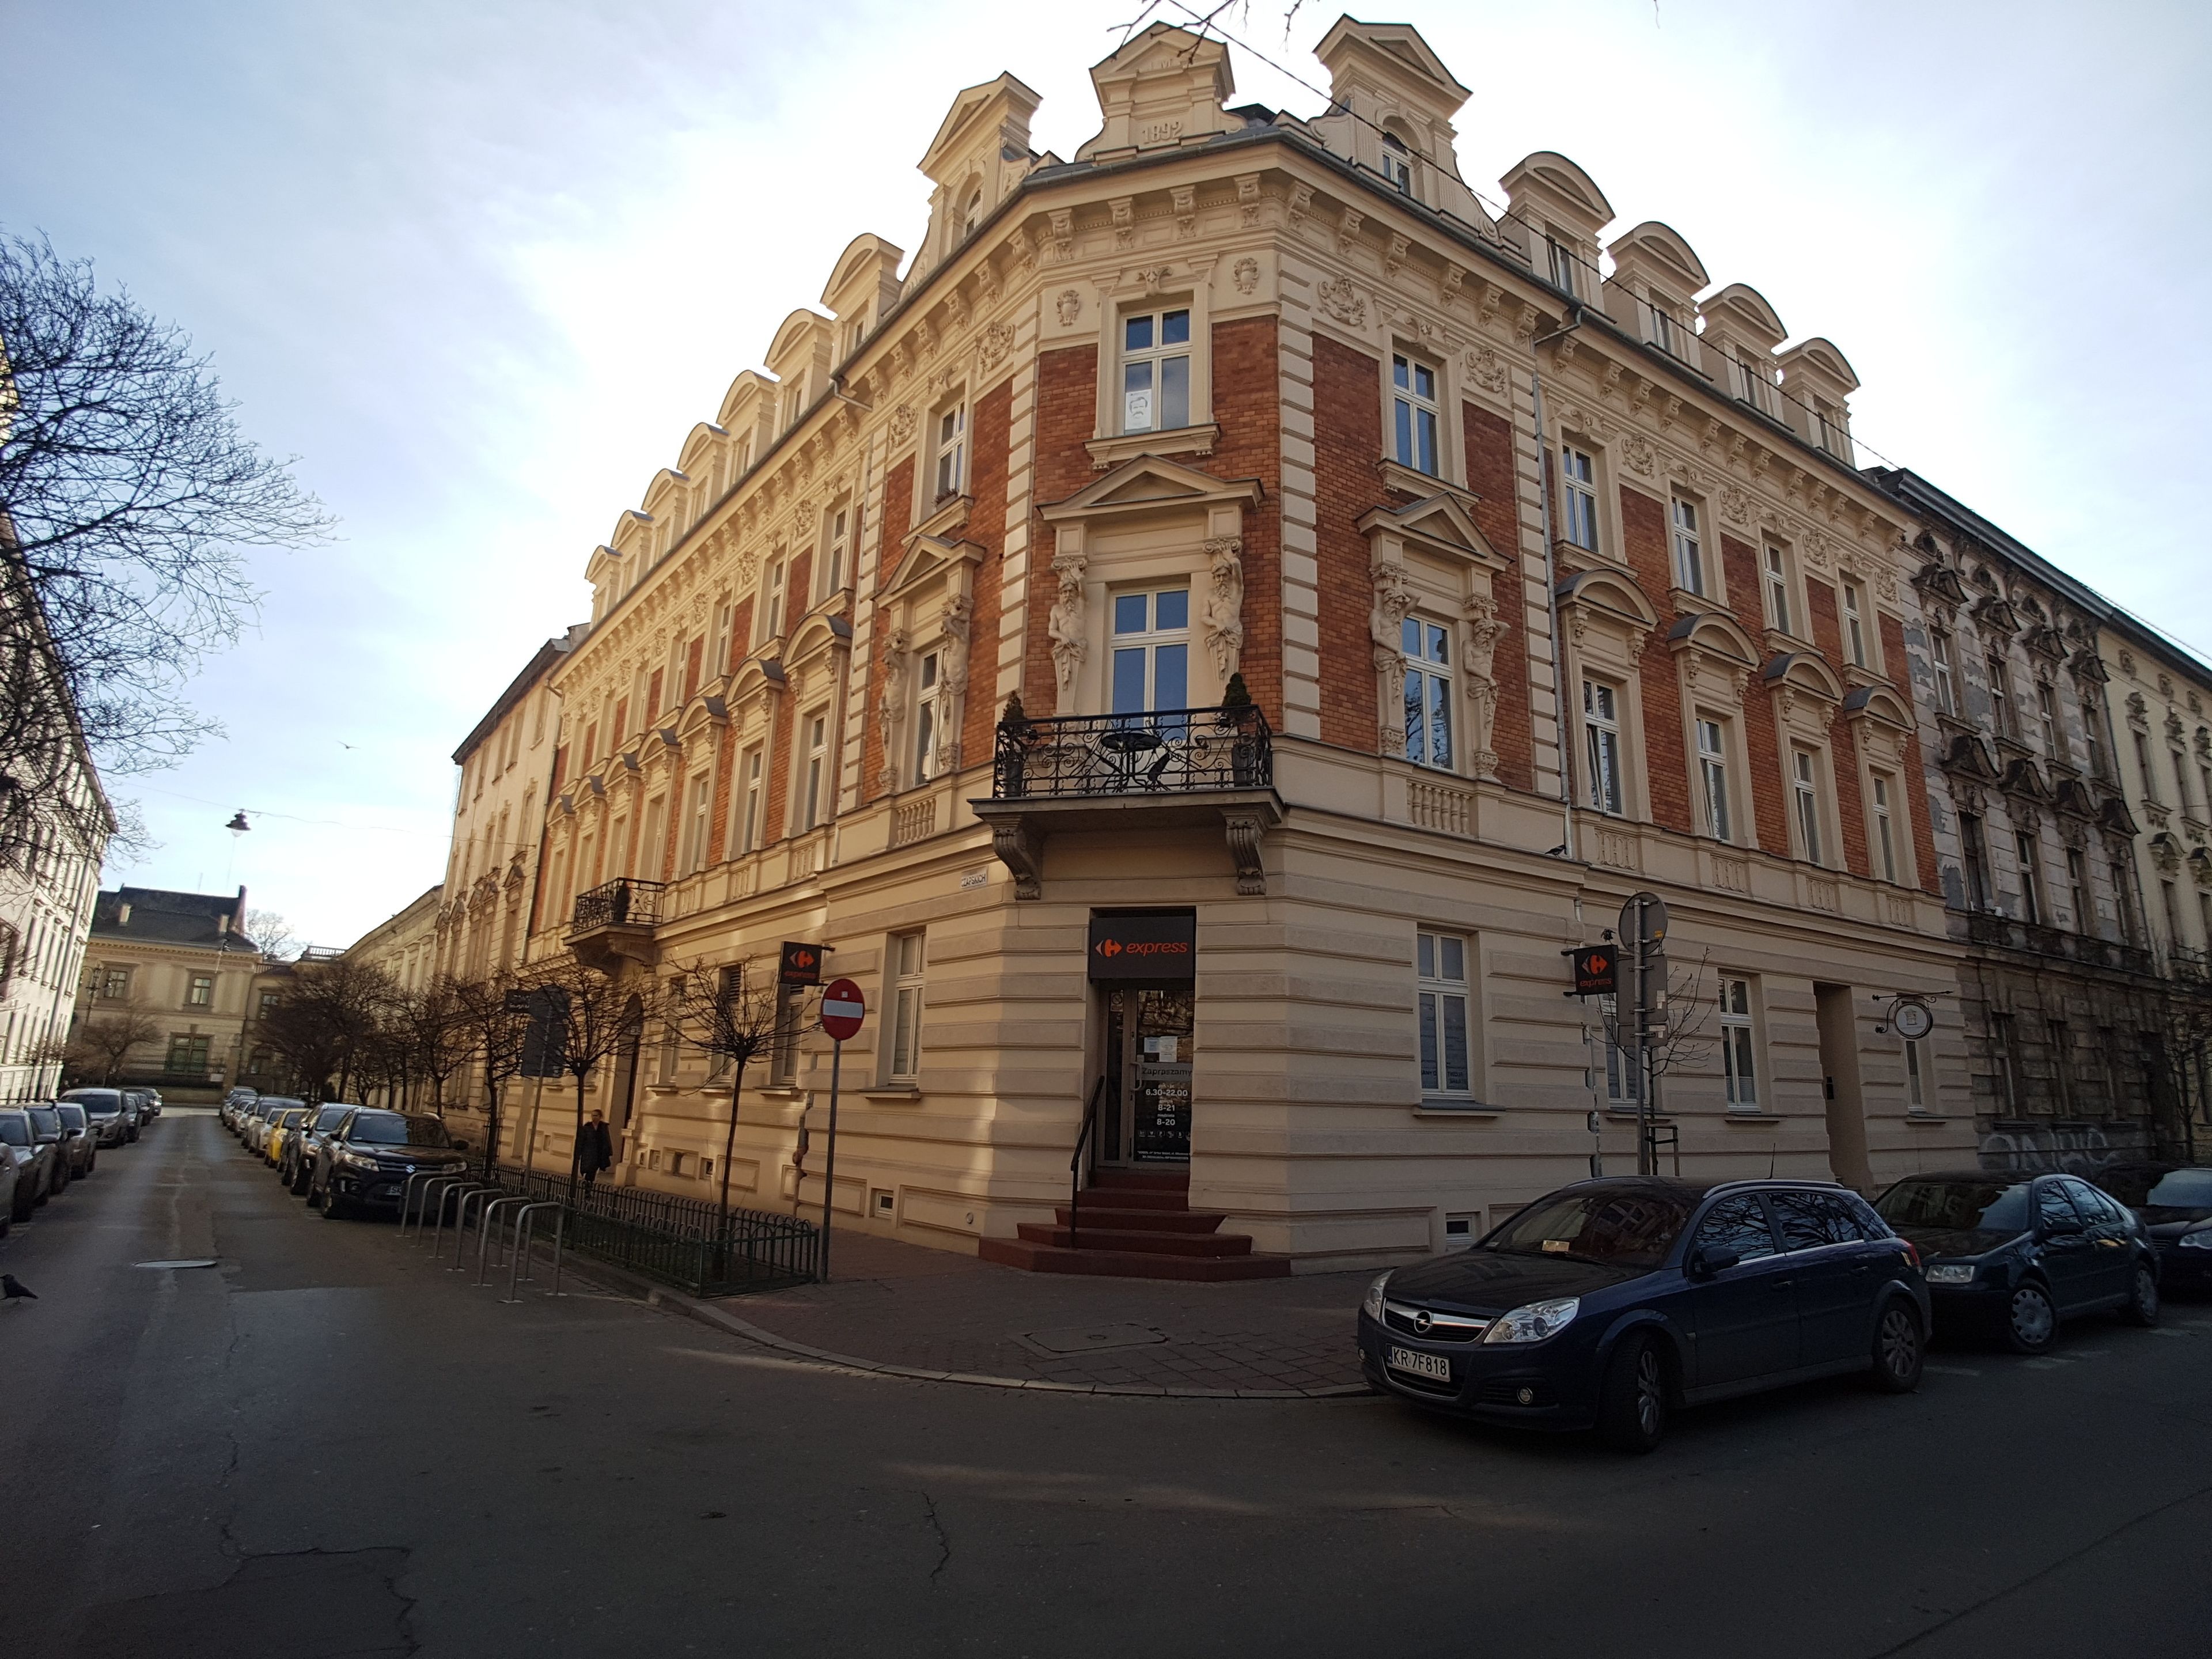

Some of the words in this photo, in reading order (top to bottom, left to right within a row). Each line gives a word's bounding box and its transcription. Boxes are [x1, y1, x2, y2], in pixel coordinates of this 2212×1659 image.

[1142, 121, 1181, 144] 1892
[1126, 942, 1188, 957] express
[1580, 978, 1612, 988] express
[1142, 1067, 1192, 1077] Zapraszamy
[1145, 1088, 1188, 1097] 6.30-22.00
[1392, 1348, 1408, 1367] KR
[1411, 1352, 1447, 1376] 7F818
